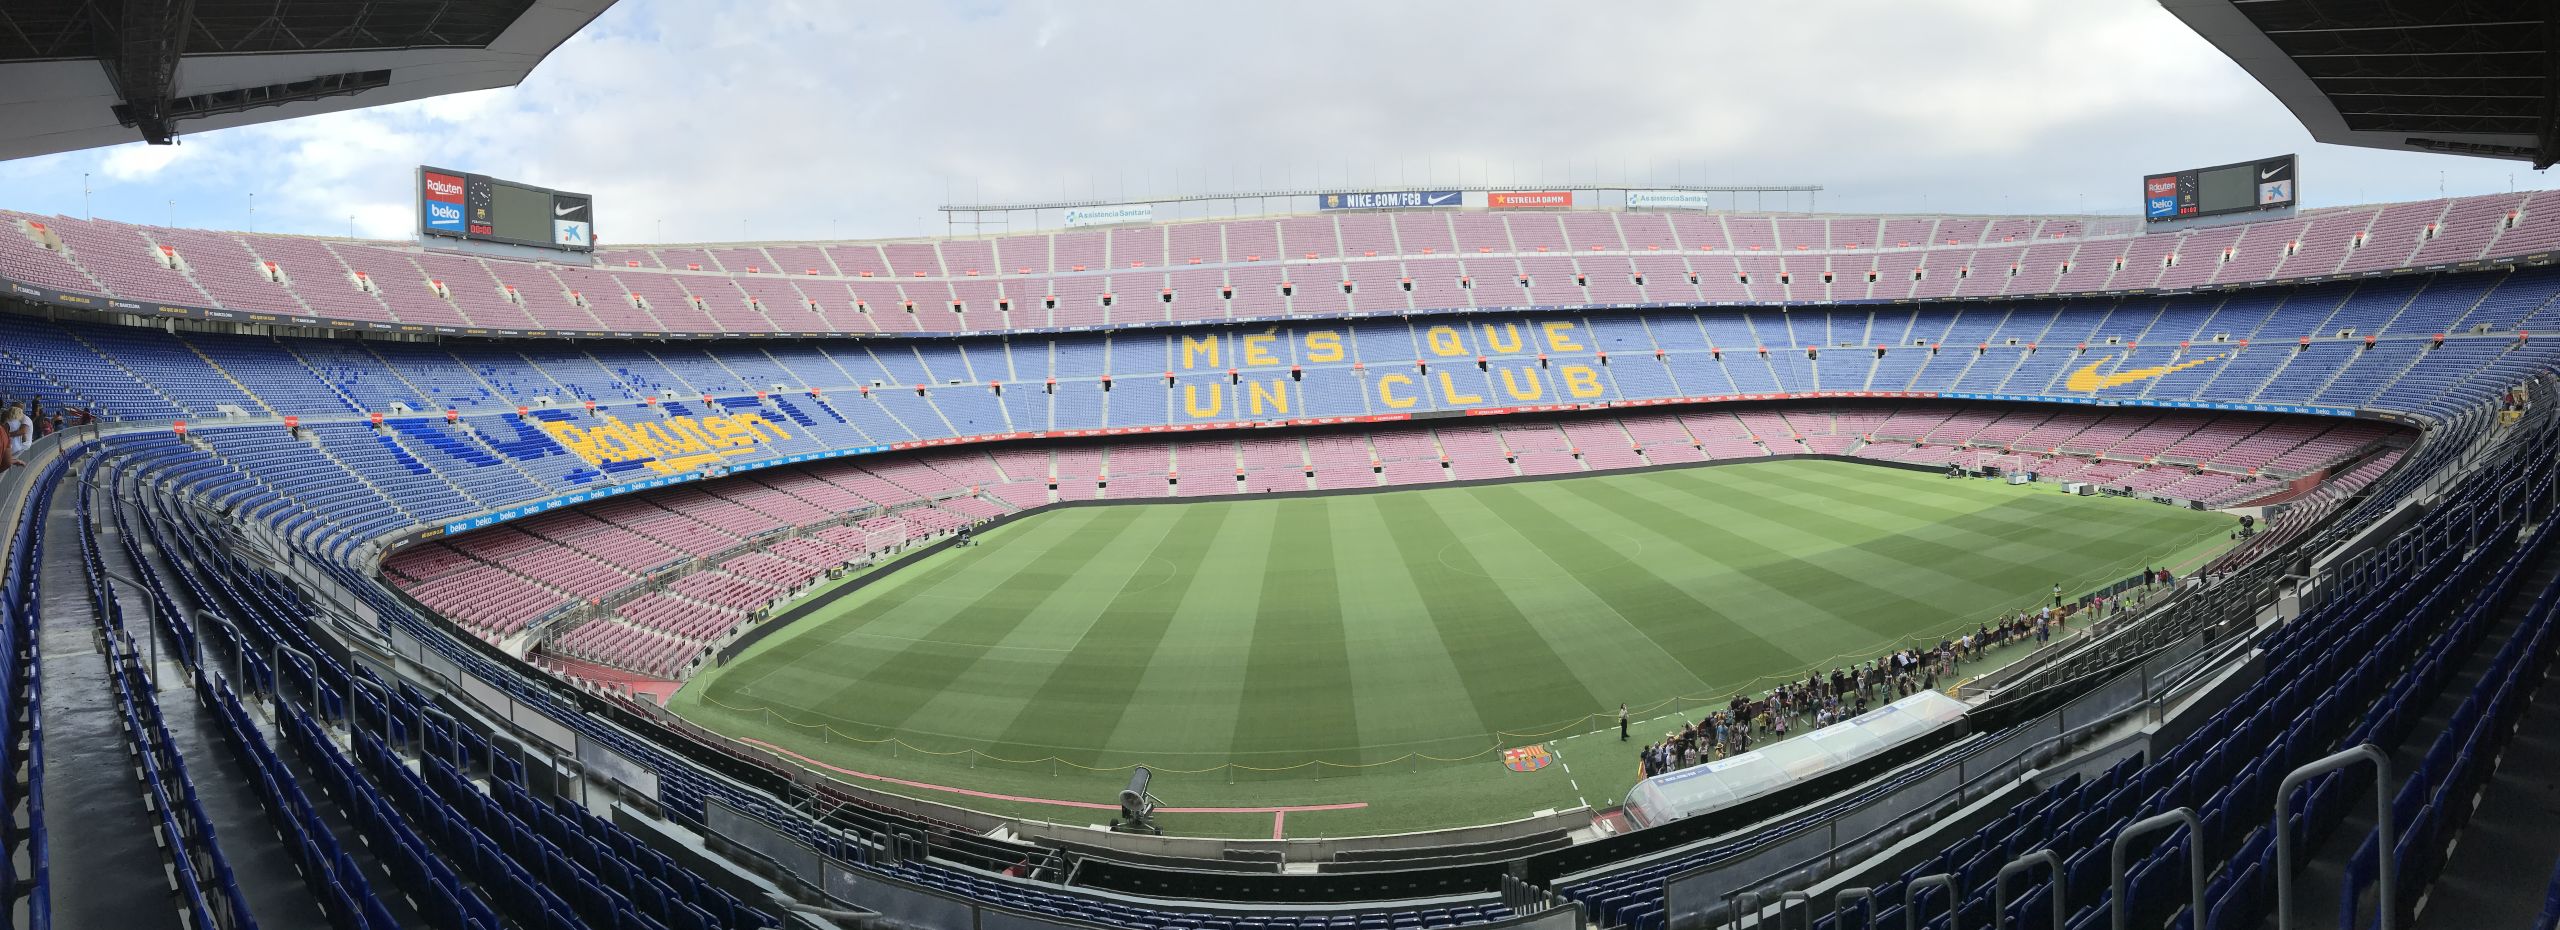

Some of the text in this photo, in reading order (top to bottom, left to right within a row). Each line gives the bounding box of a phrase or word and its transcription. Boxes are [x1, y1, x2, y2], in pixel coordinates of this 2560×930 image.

[427, 179, 462, 195] Rakuten
[2149, 182, 2176, 192] Rakuten
[1347, 193, 1421, 207] NIKE.COM/FCB
[1506, 195, 1564, 204] ESTRELLA DAMM
[2152, 200, 2172, 209] beko
[432, 204, 460, 220] beko
[1182, 322, 1584, 368] MÉS QUE
[1184, 366, 1604, 418] UN CLUB
[543, 413, 792, 465] Rakuten
[450, 472, 699, 533] beko beko beko beko beko beko beko beko beko beko beko beko
